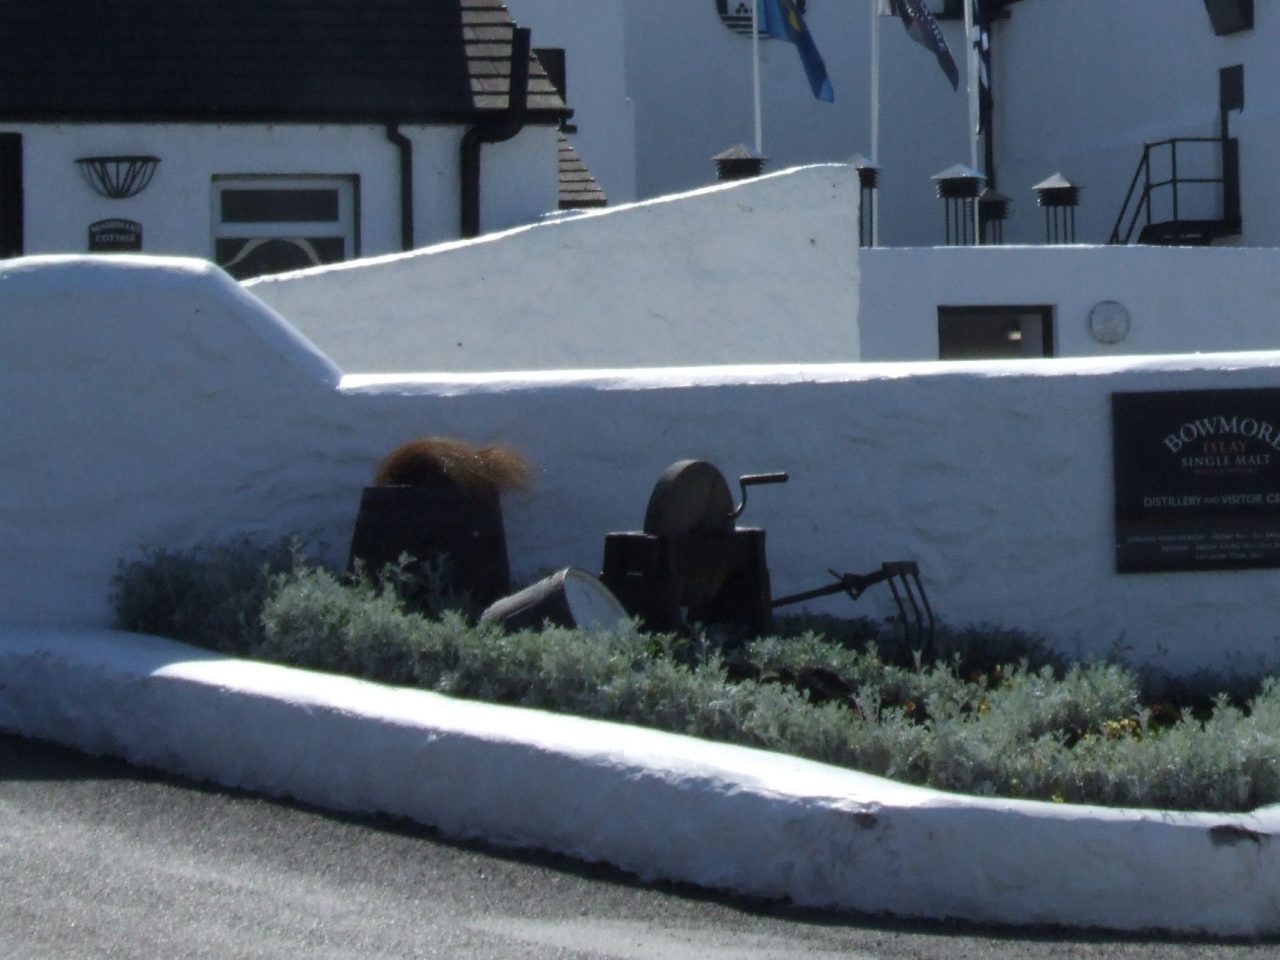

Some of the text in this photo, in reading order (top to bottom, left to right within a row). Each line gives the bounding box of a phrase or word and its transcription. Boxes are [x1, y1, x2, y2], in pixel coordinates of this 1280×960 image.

[1202, 440, 1249, 454] ISLAY
[1181, 453, 1272, 468] SINGLE MALT
[1143, 495, 1202, 508] DISTILLERY
[1220, 493, 1263, 505] VISITOR
